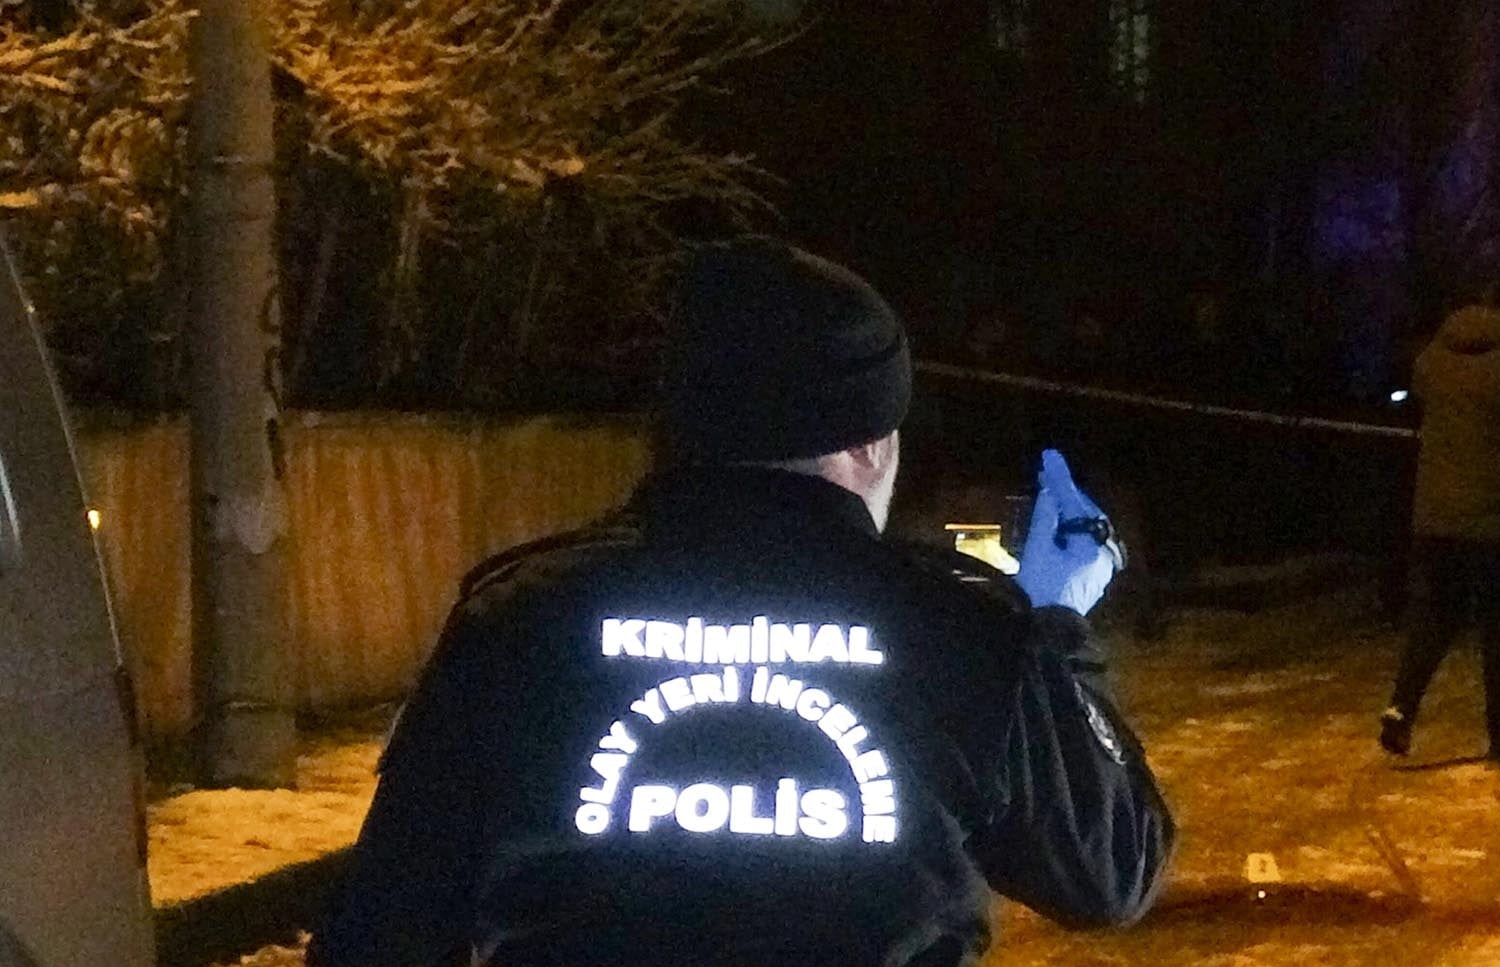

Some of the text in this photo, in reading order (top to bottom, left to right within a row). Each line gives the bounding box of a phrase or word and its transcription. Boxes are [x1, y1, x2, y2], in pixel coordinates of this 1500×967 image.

[602, 616, 884, 665] KRİMİNAL
[575, 665, 897, 843] OLAY YERİ İNCELEME
[628, 778, 850, 839] POLİS
